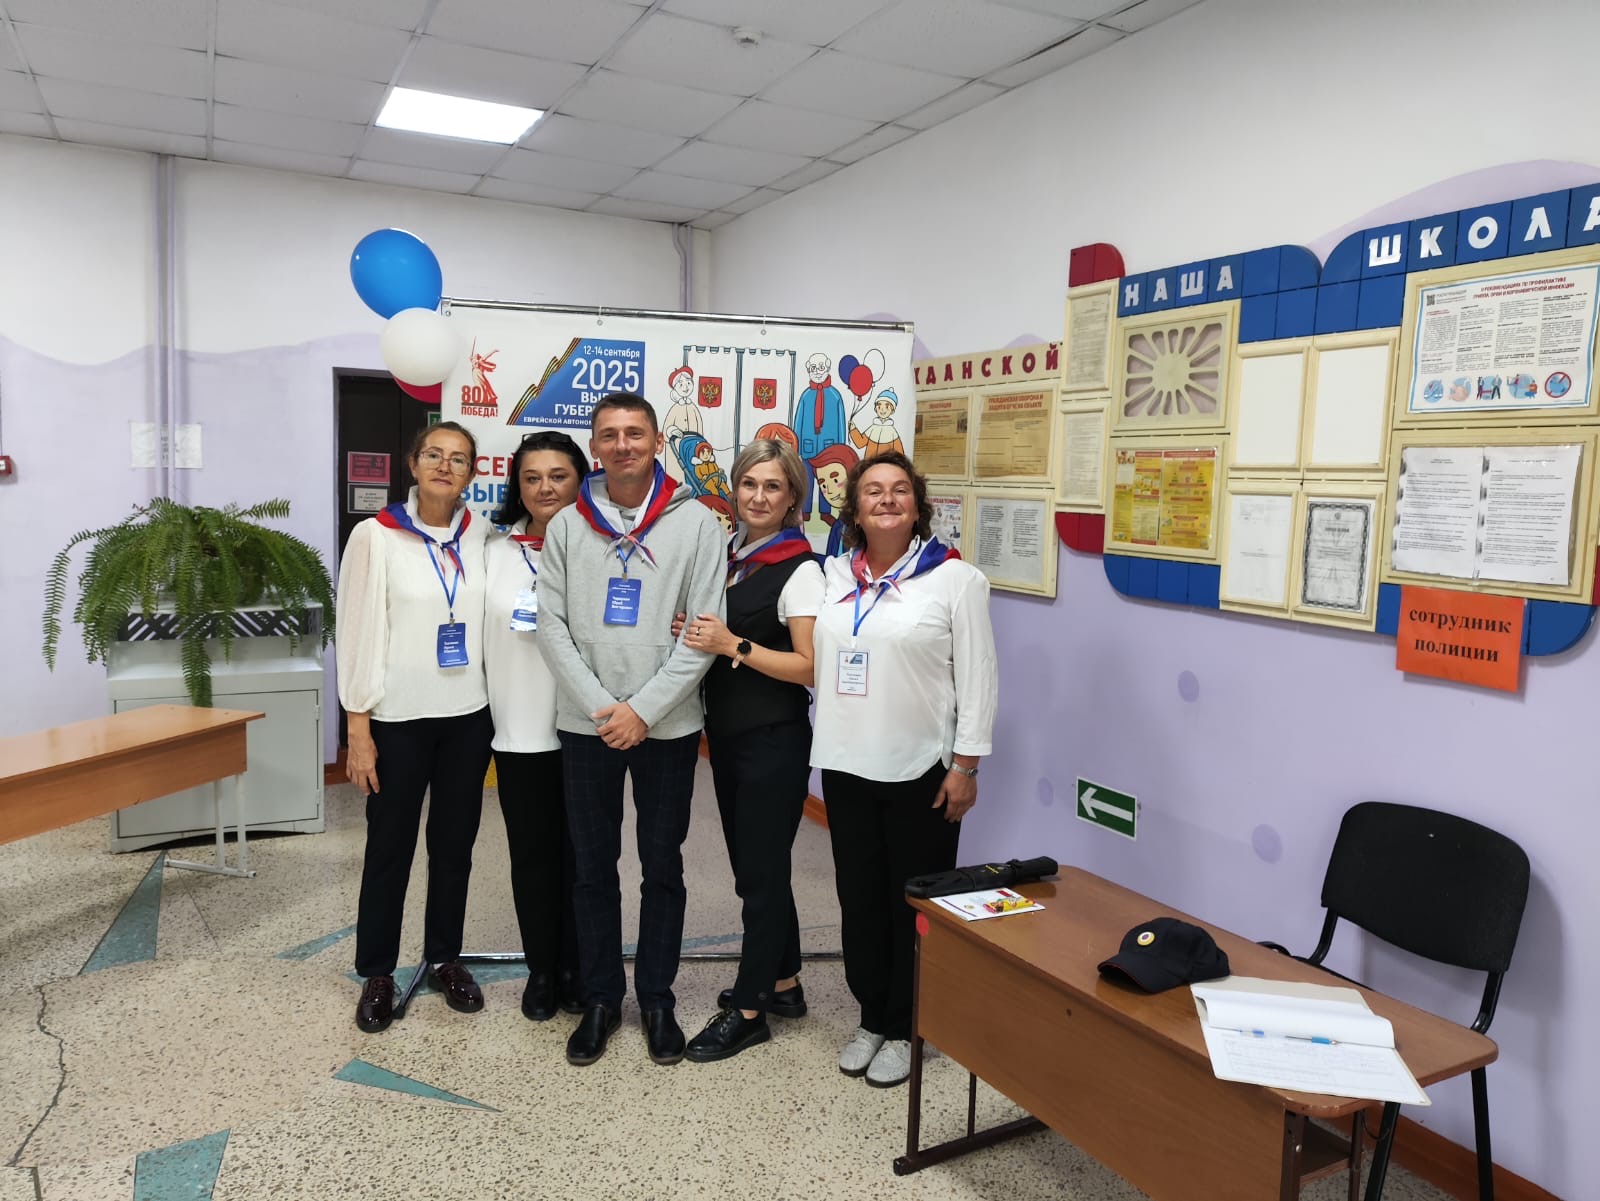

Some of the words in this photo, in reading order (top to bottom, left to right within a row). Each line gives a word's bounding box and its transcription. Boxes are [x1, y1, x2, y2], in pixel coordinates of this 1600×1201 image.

[1125, 265, 1234, 308] НАША
[584, 345, 603, 356] 12-14
[604, 347, 640, 358] сентября
[571, 358, 640, 392] 2025
[461, 385, 478, 404] 80
[461, 405, 498, 418] ПОБЕДА!
[523, 415, 562, 425] ЕВРЕЙСКОЙ
[554, 404, 595, 417] ГУБЕР
[1409, 609, 1512, 633] сотрудник
[1414, 639, 1499, 663] полиции
